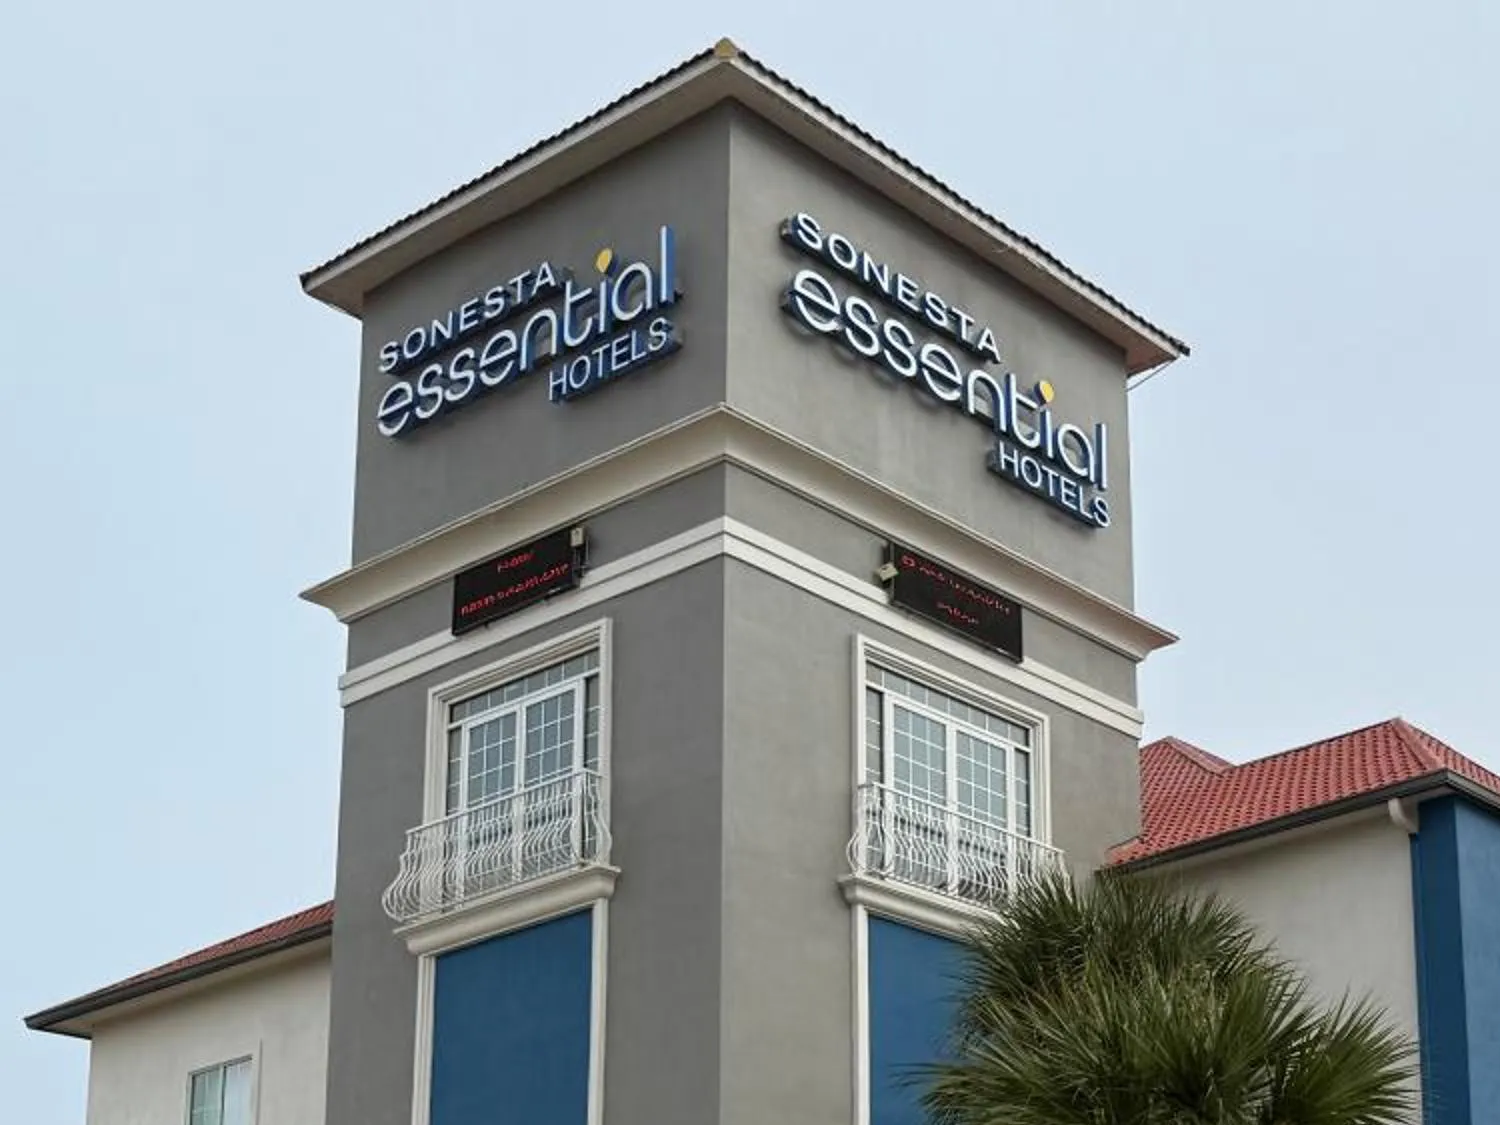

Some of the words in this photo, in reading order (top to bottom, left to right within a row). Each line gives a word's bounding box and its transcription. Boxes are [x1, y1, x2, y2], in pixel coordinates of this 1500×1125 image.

[376, 224, 674, 437] essential
[378, 260, 559, 374] SONESTA
[795, 212, 1001, 363] SONESTA
[548, 316, 674, 401] HOTELS
[792, 269, 1108, 491] essential
[999, 442, 1111, 529] HOTELS
